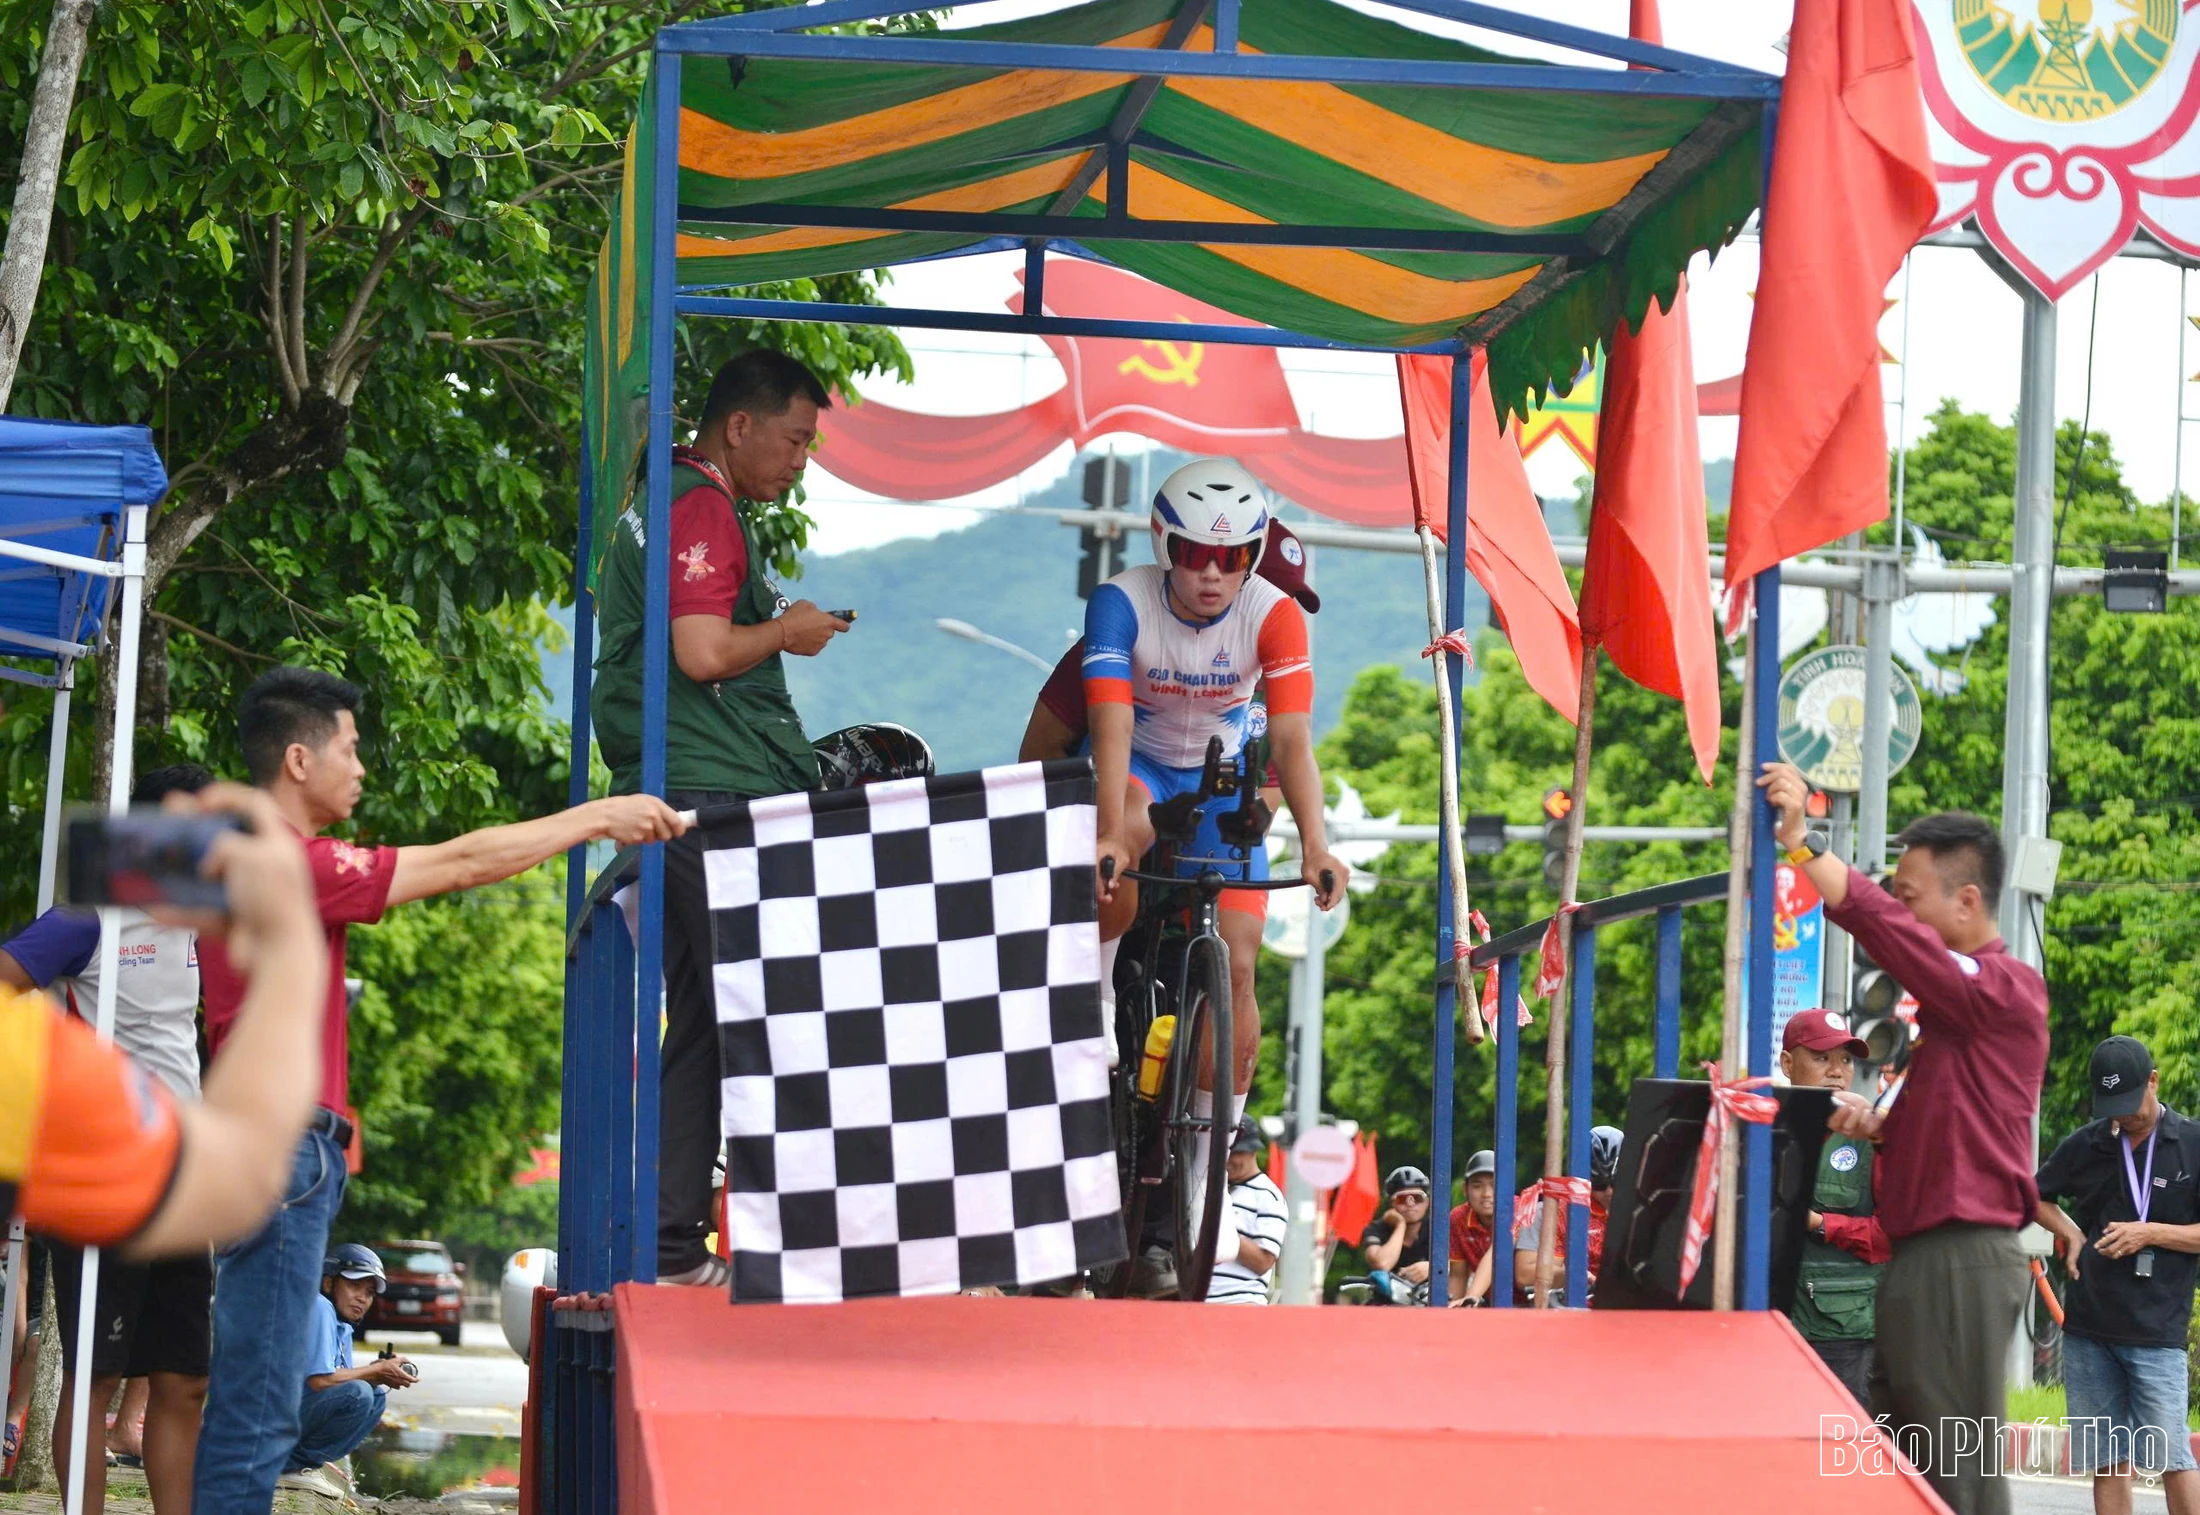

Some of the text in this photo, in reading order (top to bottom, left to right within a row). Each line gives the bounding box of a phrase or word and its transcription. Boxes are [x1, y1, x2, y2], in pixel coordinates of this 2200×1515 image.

[1193, 687, 1234, 699] LONG
[131, 944, 156, 955] LONG
[138, 956, 155, 965] Team
